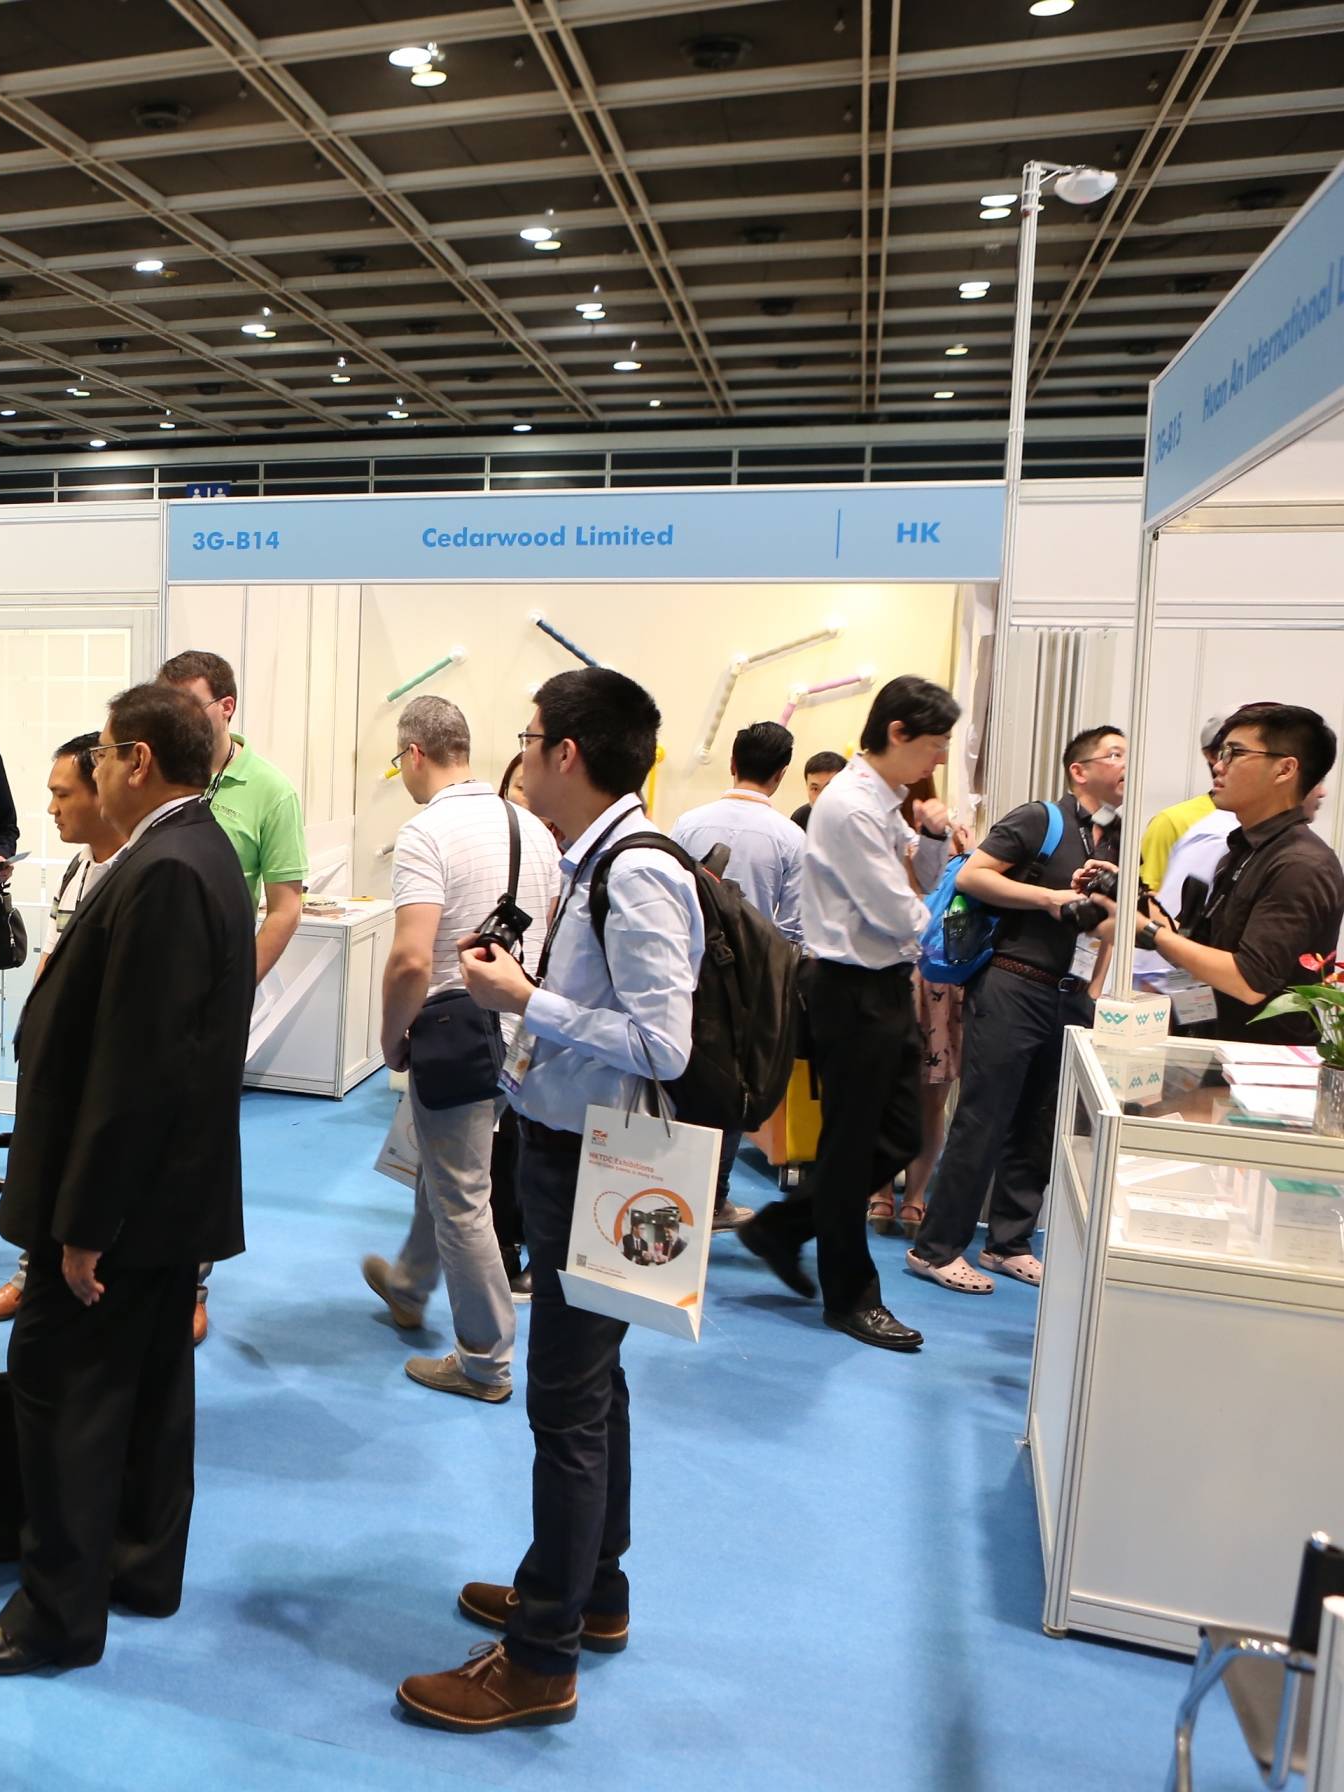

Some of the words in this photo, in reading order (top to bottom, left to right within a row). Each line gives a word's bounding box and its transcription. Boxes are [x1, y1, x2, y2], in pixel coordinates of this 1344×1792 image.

[1229, 358, 1244, 400] An
[1246, 262, 1334, 384] International
[192, 529, 280, 552] 3G-B14
[421, 525, 566, 548] Cedarwood
[575, 524, 674, 546] Limited
[896, 521, 941, 544] HK
[615, 1158, 654, 1173] Exhibitions
